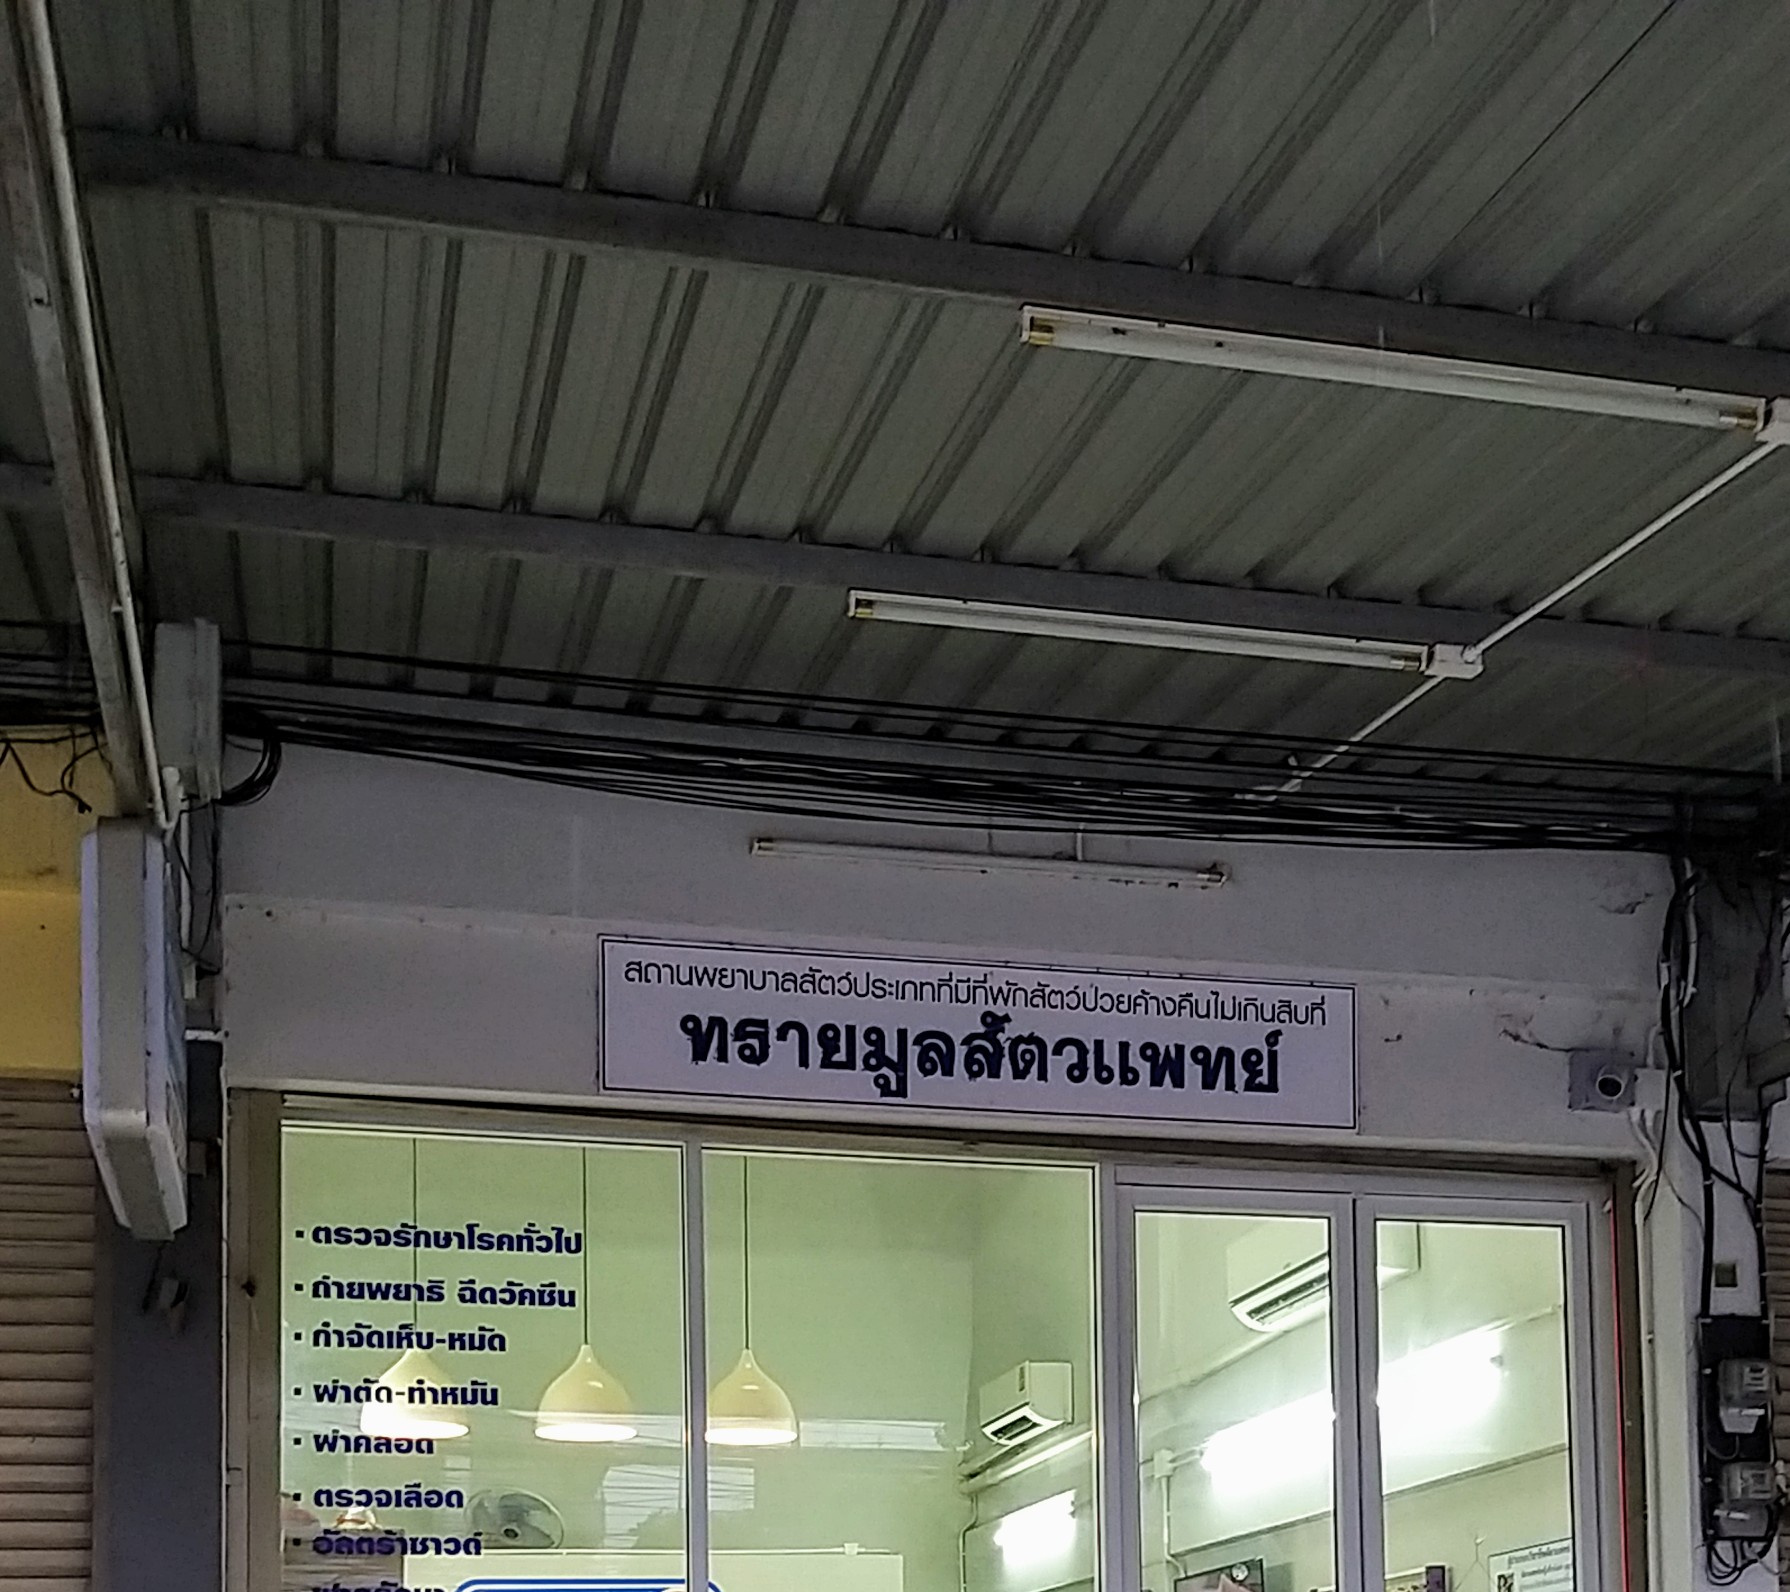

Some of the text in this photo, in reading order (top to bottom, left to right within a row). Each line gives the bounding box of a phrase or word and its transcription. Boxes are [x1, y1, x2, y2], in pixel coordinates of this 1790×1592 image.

[624, 959, 1327, 1026] สถานพยาบาลสัตว์ประเภทที่มีที่พักสัตว์ป่วยค้างคืนไม่เกินสิบที่
[679, 1009, 1283, 1099] ทรายมูลสัตวแพทย์
[312, 1222, 583, 1254] ตรวจรักษาโรคทั่วไป
[312, 1275, 577, 1308] ถ่ายพยาธิ ฉีดวัคซีน
[312, 1321, 507, 1352] กำจัดเห็บ-หมัด
[313, 1378, 499, 1406] ผ่าตัด-ทำหมัน
[313, 1429, 434, 1454] ผ่าคลอด
[313, 1483, 464, 1508] ตรวจเลือด
[312, 1528, 484, 1556] อัลตร้าซาวด์
